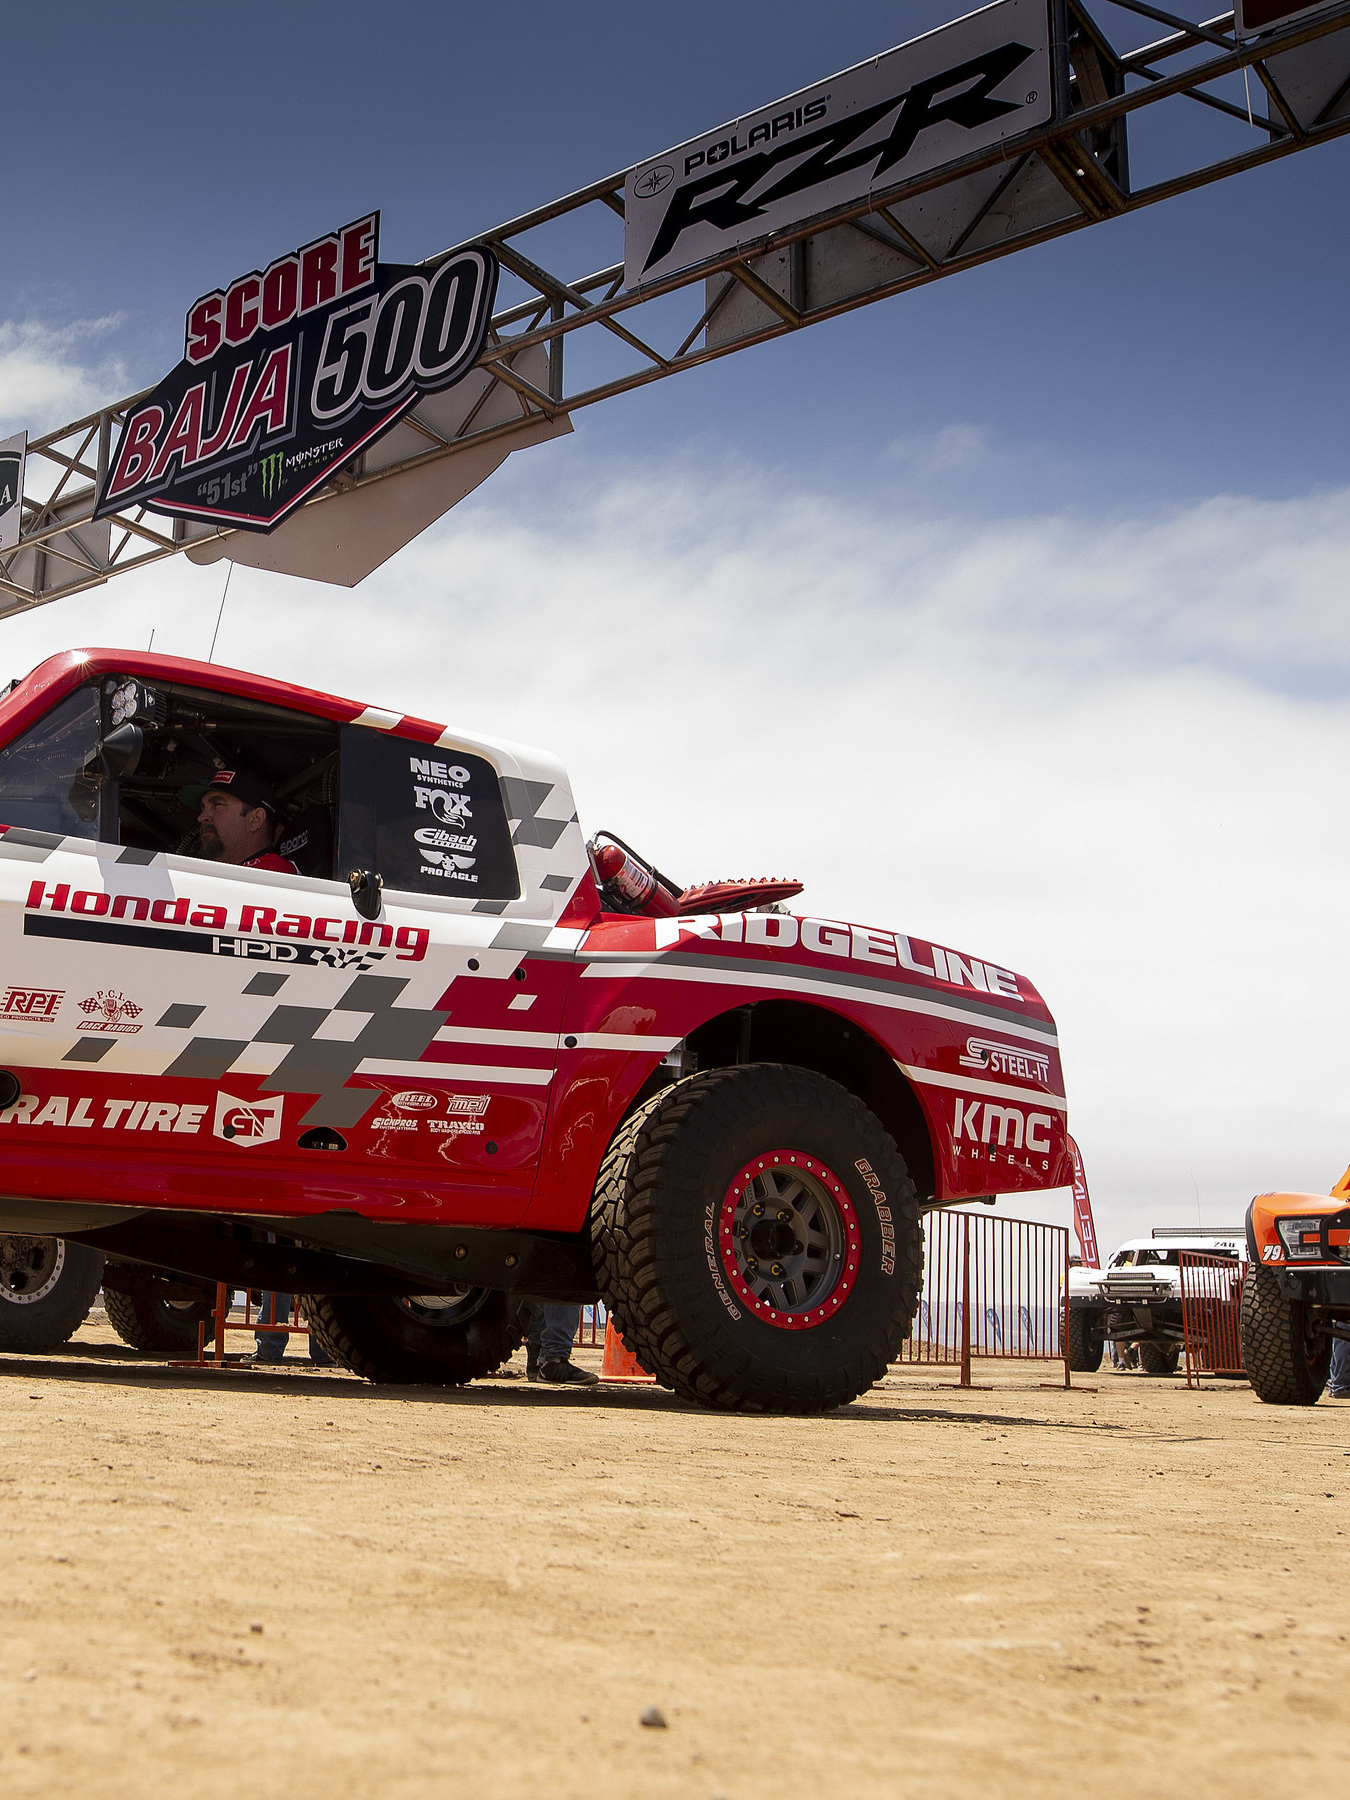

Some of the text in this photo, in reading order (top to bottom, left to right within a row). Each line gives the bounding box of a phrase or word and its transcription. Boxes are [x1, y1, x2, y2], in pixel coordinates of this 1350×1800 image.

[684, 96, 827, 177] POLARIS
[641, 41, 1036, 275] RZR
[187, 215, 375, 365] SCORE
[106, 251, 485, 499] BAJA 500
[285, 437, 344, 468] MONSTER
[293, 453, 335, 473] ENERGY
[410, 757, 470, 783] NEO
[417, 774, 464, 789] SYNTHETICS
[414, 786, 472, 829] FOX
[414, 828, 477, 848] Eibach
[420, 866, 478, 882] PRO EAGLE
[24, 881, 431, 962] Honda Racing
[212, 936, 298, 961] HPD
[655, 911, 1024, 1002] RIDGELINE
[3, 991, 58, 1015] RPI
[96, 990, 125, 1001] P.C.I.
[80, 1021, 139, 1032] RACE RADIOS
[990, 1052, 1049, 1083] STEEL-IT
[101, 1099, 209, 1133] TIRE
[953, 1097, 1051, 1153] KMC
[854, 1158, 896, 1276] GRABBER
[704, 1202, 742, 1320] GENERAL
